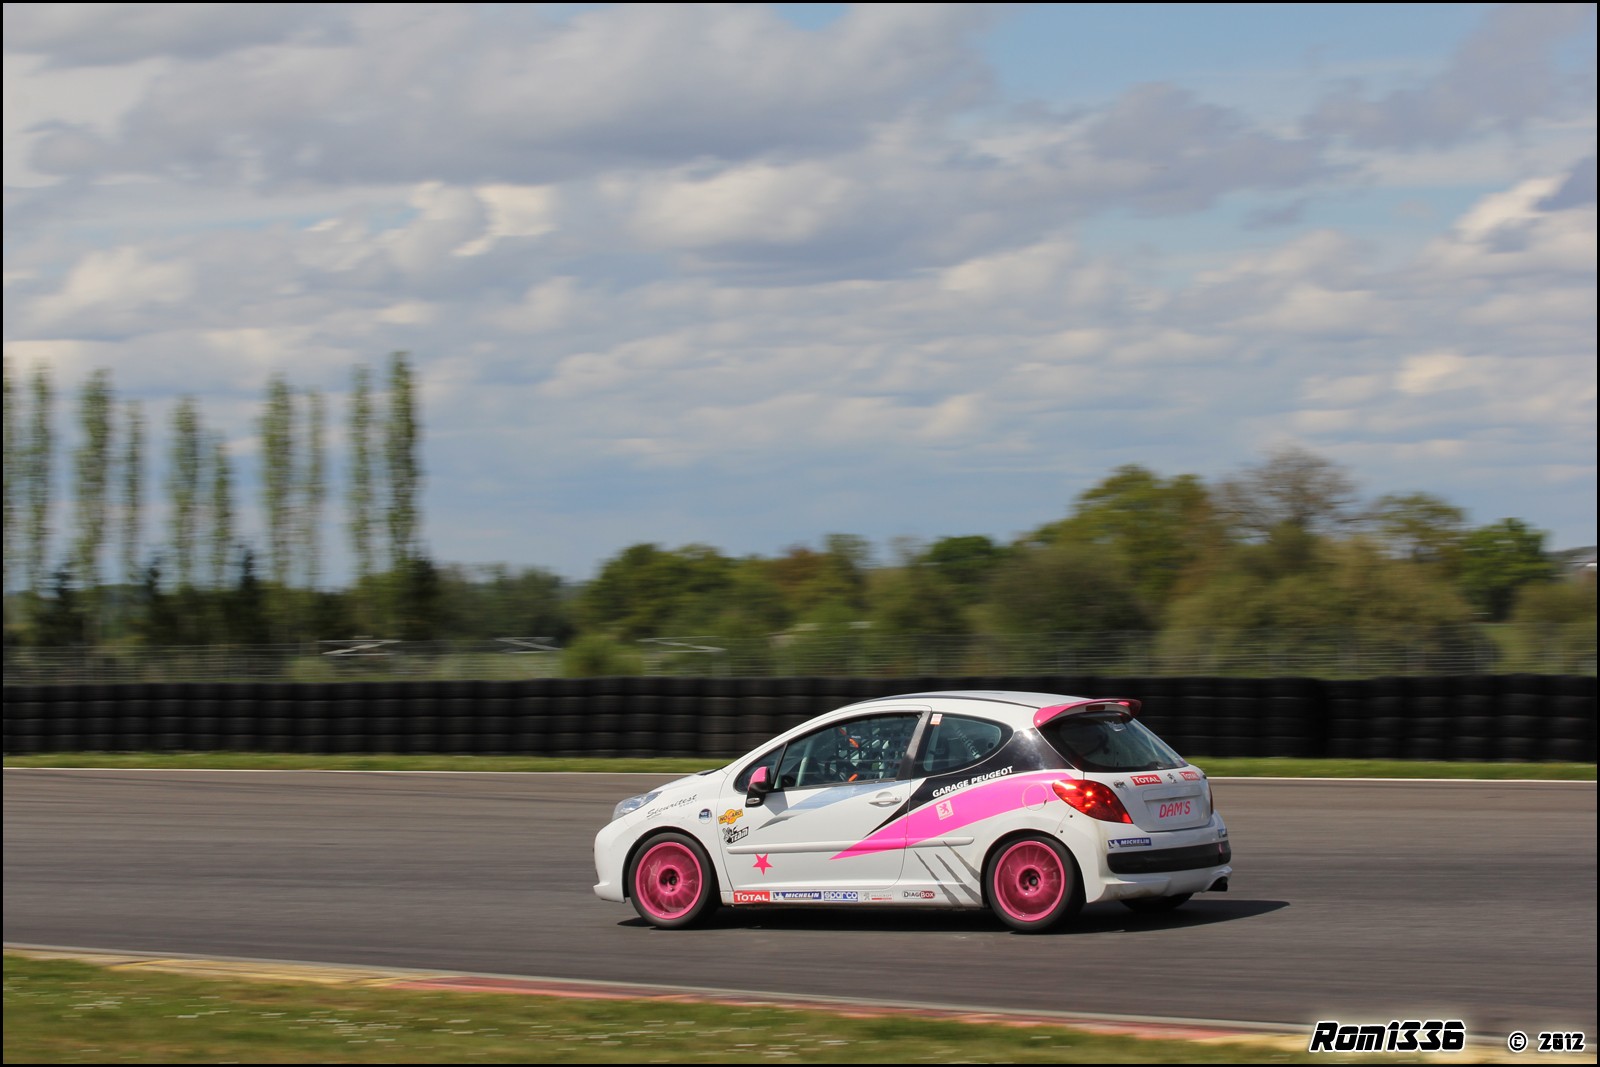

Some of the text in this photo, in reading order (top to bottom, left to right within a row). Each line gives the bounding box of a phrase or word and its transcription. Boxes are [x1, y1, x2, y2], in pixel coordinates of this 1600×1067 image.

[932, 765, 1013, 798] GARAGE PEUGEOT
[1134, 775, 1161, 784] TOTAL
[1159, 801, 1191, 818] DAM'S
[735, 892, 769, 902] TOTAL
[824, 891, 858, 900] sparco
